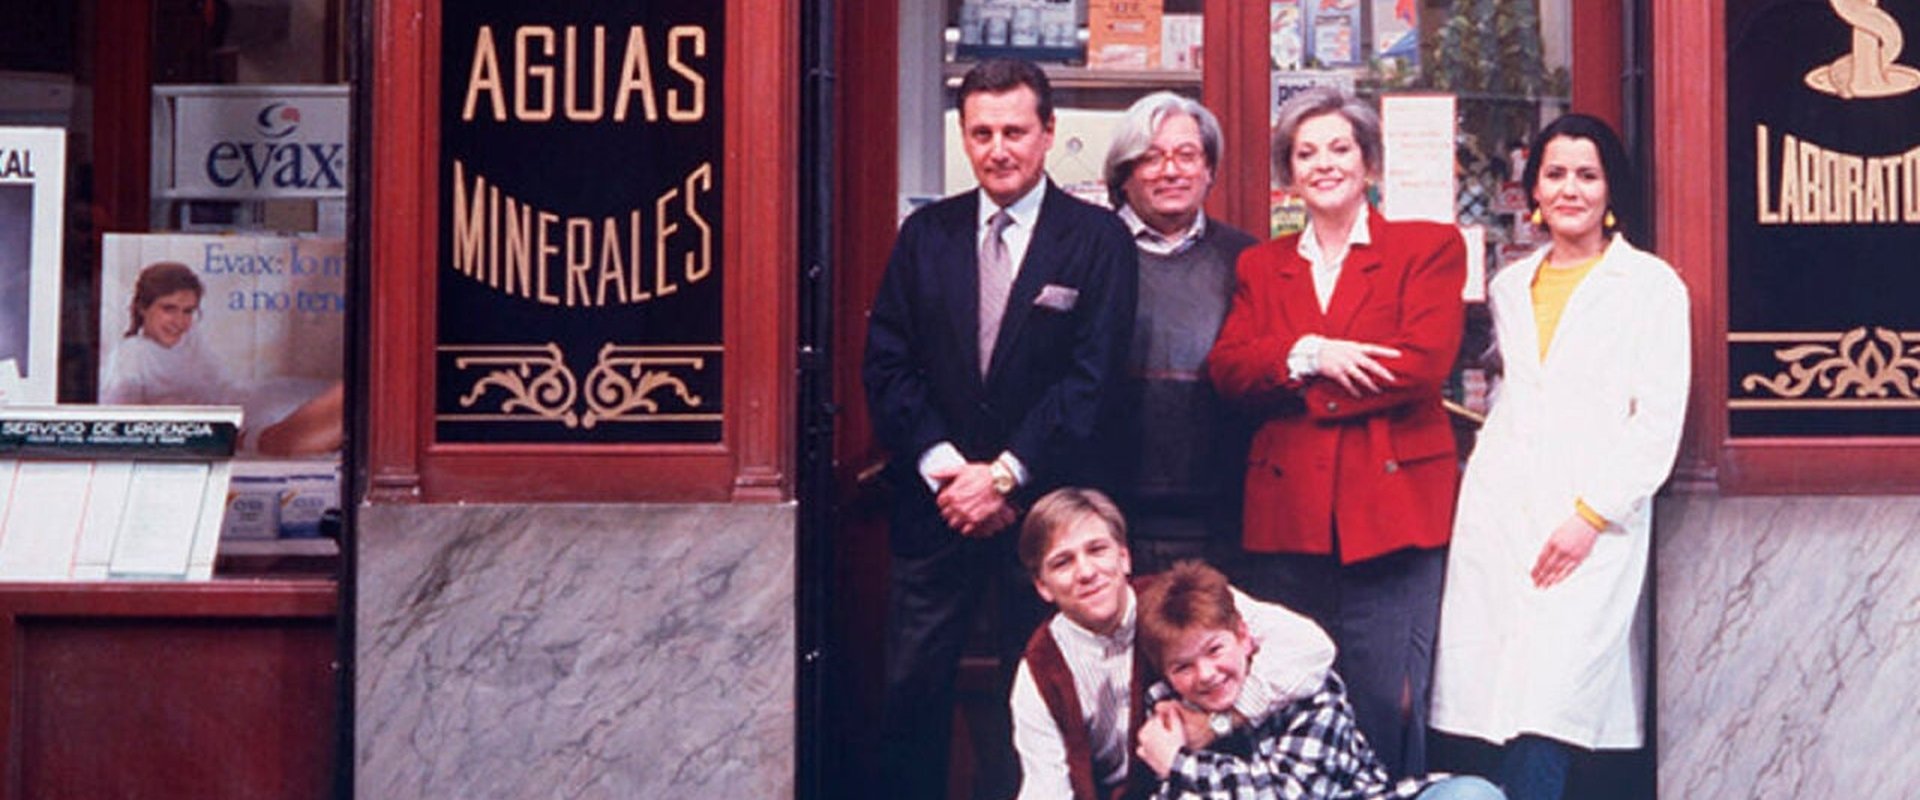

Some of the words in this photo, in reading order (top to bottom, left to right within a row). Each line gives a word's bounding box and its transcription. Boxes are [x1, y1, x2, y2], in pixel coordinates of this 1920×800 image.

[462, 25, 706, 122] AGUAS
[0, 149, 35, 179] AL
[206, 139, 344, 189] evax
[452, 159, 712, 307] MINERALES
[204, 242, 283, 275] Evax:
[290, 241, 319, 275] lo
[229, 290, 246, 311] a
[253, 290, 290, 311] no
[1, 421, 86, 436] SERVICIO
[92, 421, 119, 436] DE
[124, 421, 213, 438] URGENCIA
